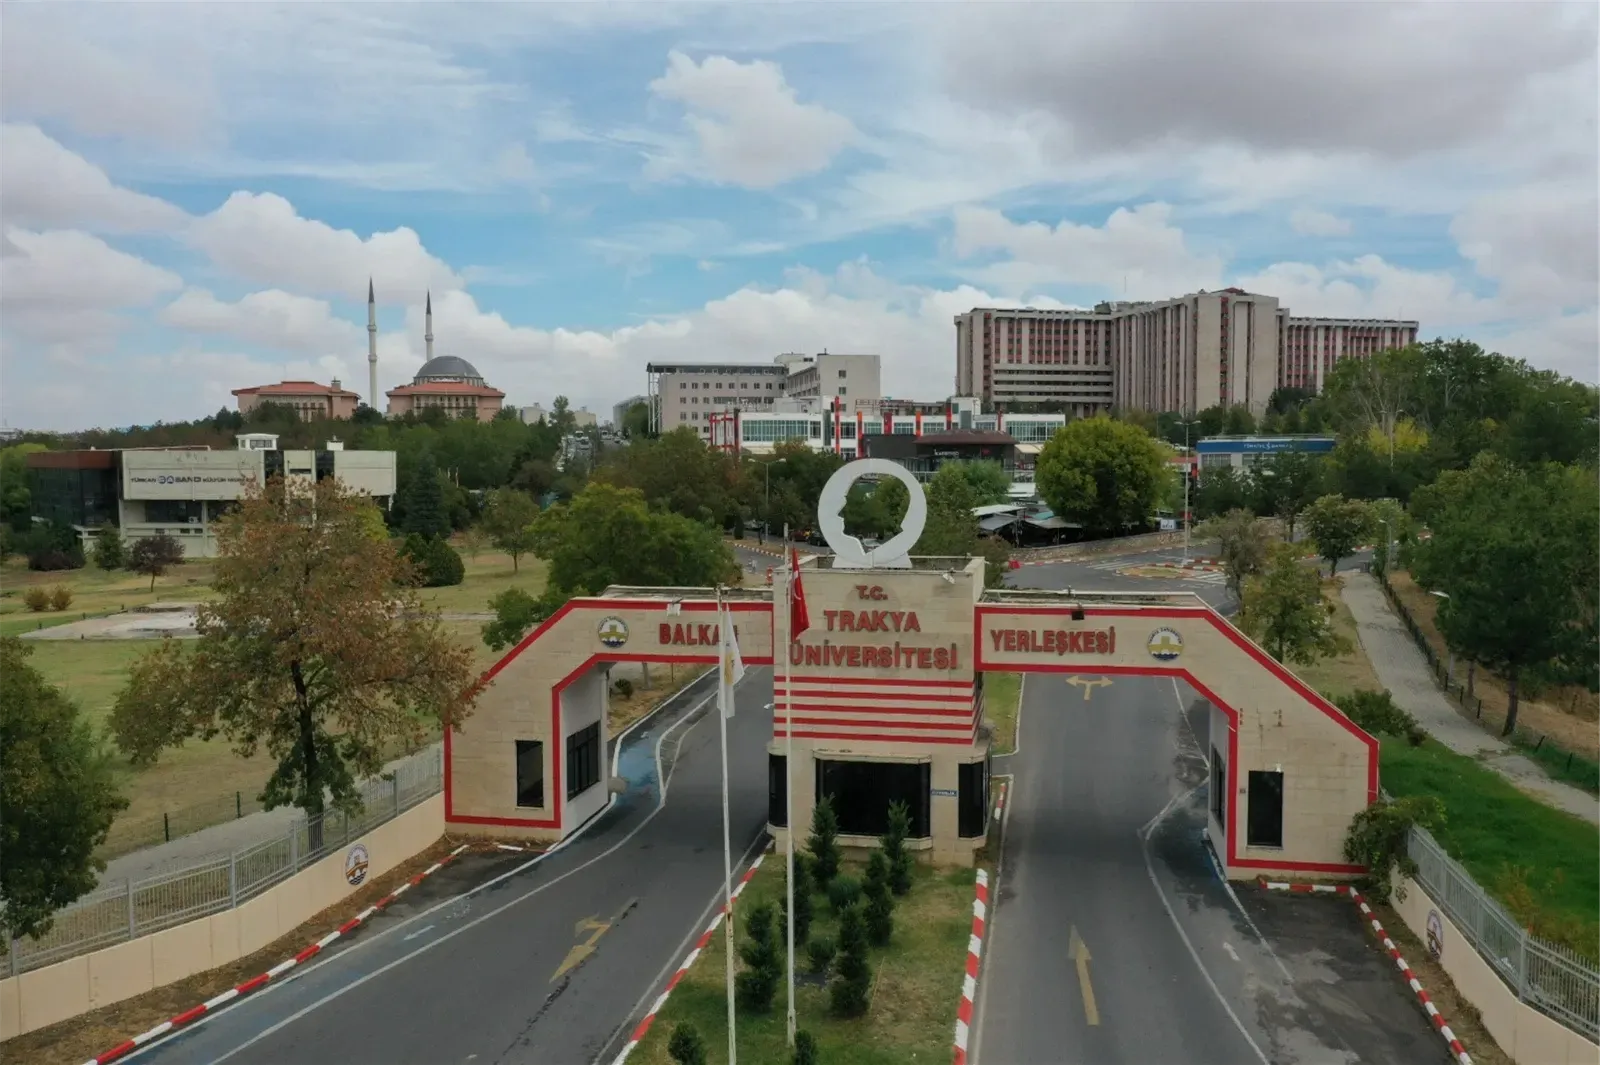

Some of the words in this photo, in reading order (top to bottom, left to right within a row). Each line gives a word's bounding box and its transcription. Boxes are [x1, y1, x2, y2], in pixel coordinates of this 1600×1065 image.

[856, 585, 888, 600] T.C.
[824, 610, 920, 632] TRAKYA
[659, 623, 739, 646] BALKA
[990, 626, 1116, 656] YERLEŞKESİ
[789, 639, 958, 670] ÜNİVERSİTESİ
